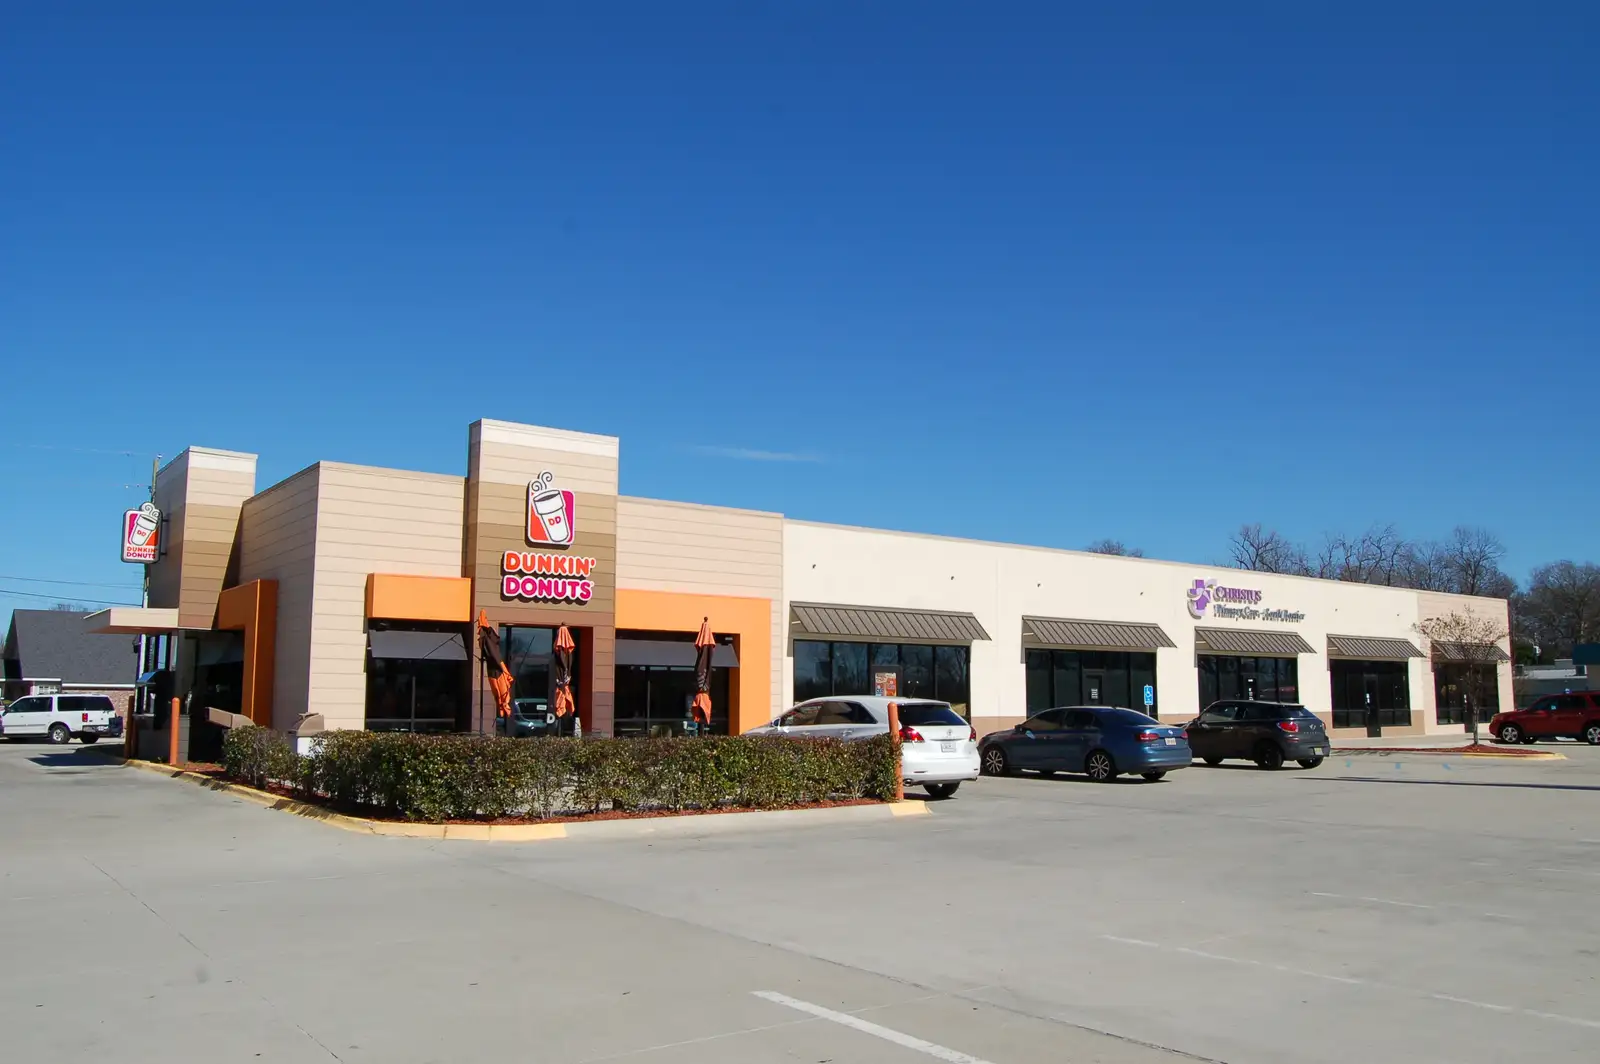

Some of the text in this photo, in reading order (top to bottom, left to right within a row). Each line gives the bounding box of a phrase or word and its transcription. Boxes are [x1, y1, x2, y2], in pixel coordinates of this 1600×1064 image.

[547, 516, 562, 526] DD
[505, 552, 595, 576] DUNKIN'
[504, 576, 592, 600] DONUTS
[1215, 604, 1243, 619] Primary
[1244, 606, 1259, 618] Care
